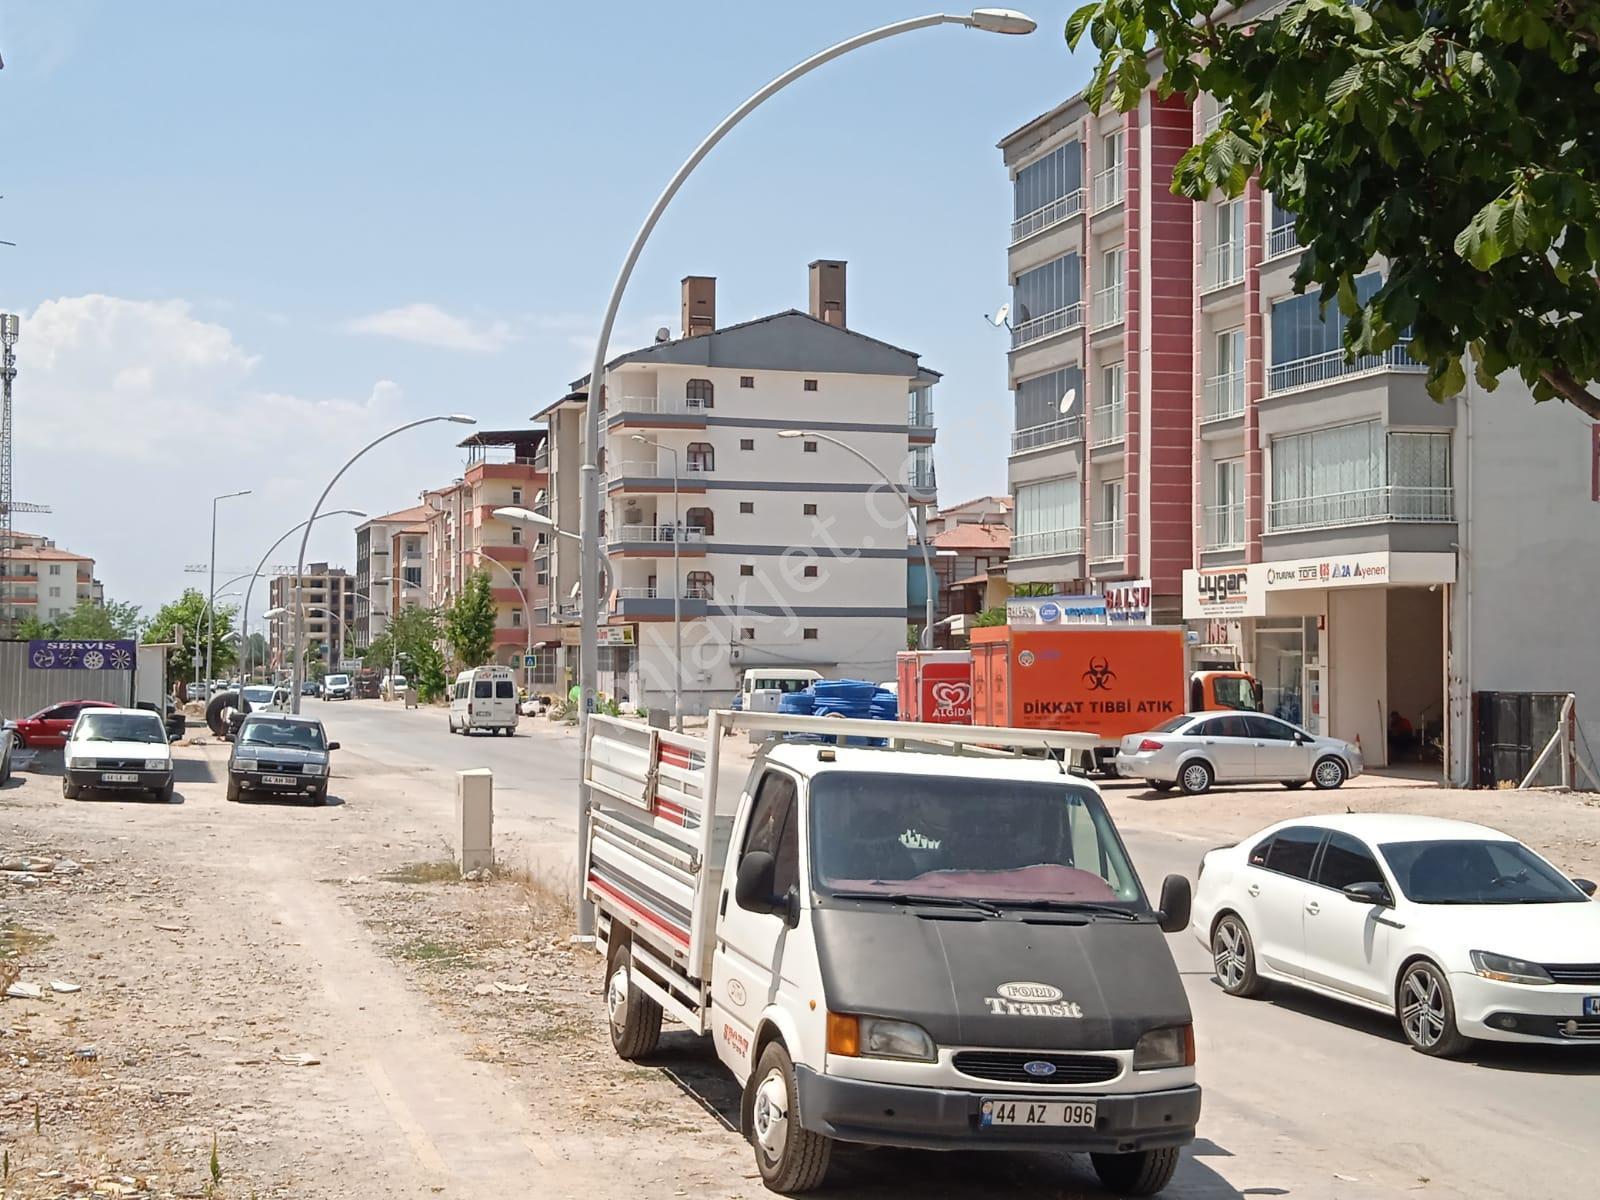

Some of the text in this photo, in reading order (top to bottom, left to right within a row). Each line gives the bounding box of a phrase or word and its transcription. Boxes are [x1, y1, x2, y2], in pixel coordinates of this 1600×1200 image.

[1198, 573, 1248, 601] uygar
[1023, 699, 1084, 714] DİKKAT
[1137, 700, 1173, 713] ATIK
[1008, 985, 1056, 998] FORD
[984, 997, 1084, 1018] Transit
[996, 1103, 1093, 1124] 44 AZ 096
